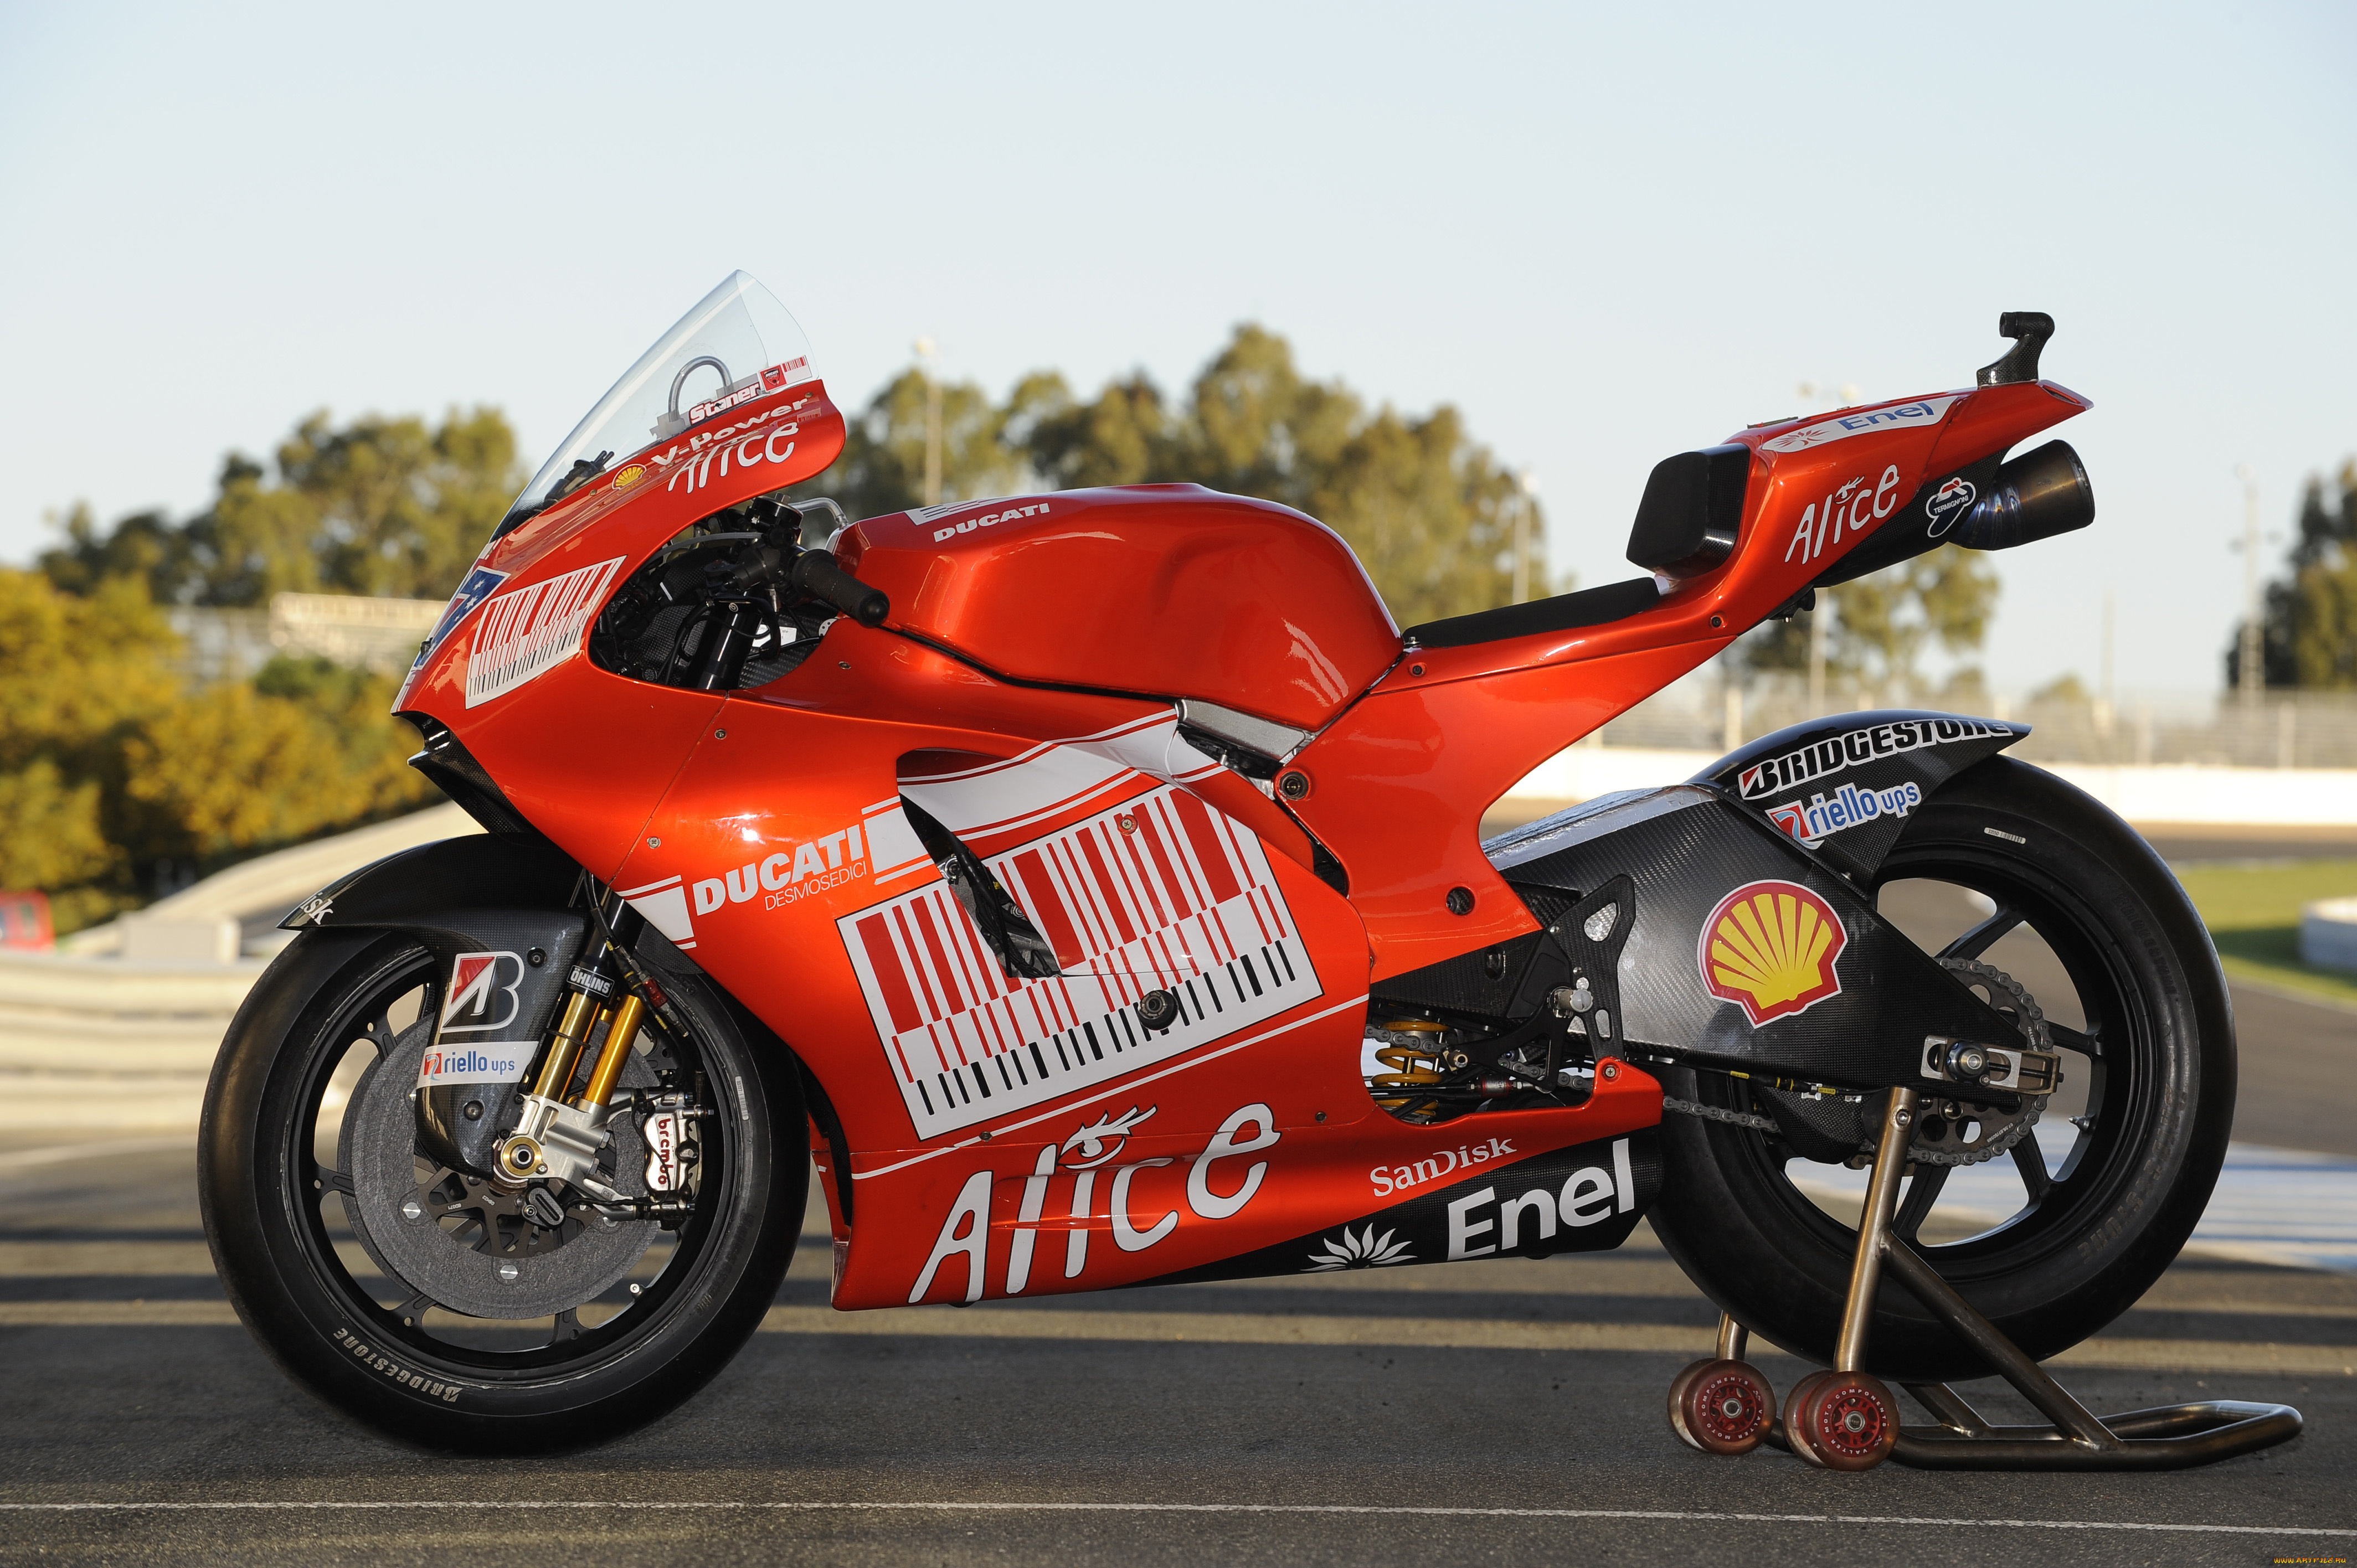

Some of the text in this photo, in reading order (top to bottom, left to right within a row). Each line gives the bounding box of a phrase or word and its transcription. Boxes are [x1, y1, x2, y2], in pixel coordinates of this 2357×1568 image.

[651, 398, 807, 466] V-Power
[689, 382, 760, 425] Stoner
[1837, 402, 1935, 431] Enel
[667, 422, 799, 494] Alice
[933, 503, 1050, 543] DUCATI
[1784, 464, 1900, 565] Alice
[1933, 495, 1969, 514] TERMIGNONI
[1738, 718, 2013, 800] BRIDGESTONE
[1808, 783, 1919, 834] riello ups
[692, 824, 864, 916] DUCATI
[764, 860, 867, 911] DESMOSEDICI
[570, 967, 610, 994] ÖHLINS
[444, 1050, 516, 1075] riello ups
[1370, 1137, 1517, 1197] SanDisk
[908, 1102, 1282, 1305] Alice
[1447, 1138, 1635, 1262] Enel
[333, 1327, 463, 1402] BRIDGESTONE
[1701, 1376, 1763, 1440] VALTER MOTO COMPONENTS
[1824, 1389, 1886, 1454] VALTER MOTO COMPONENTS
